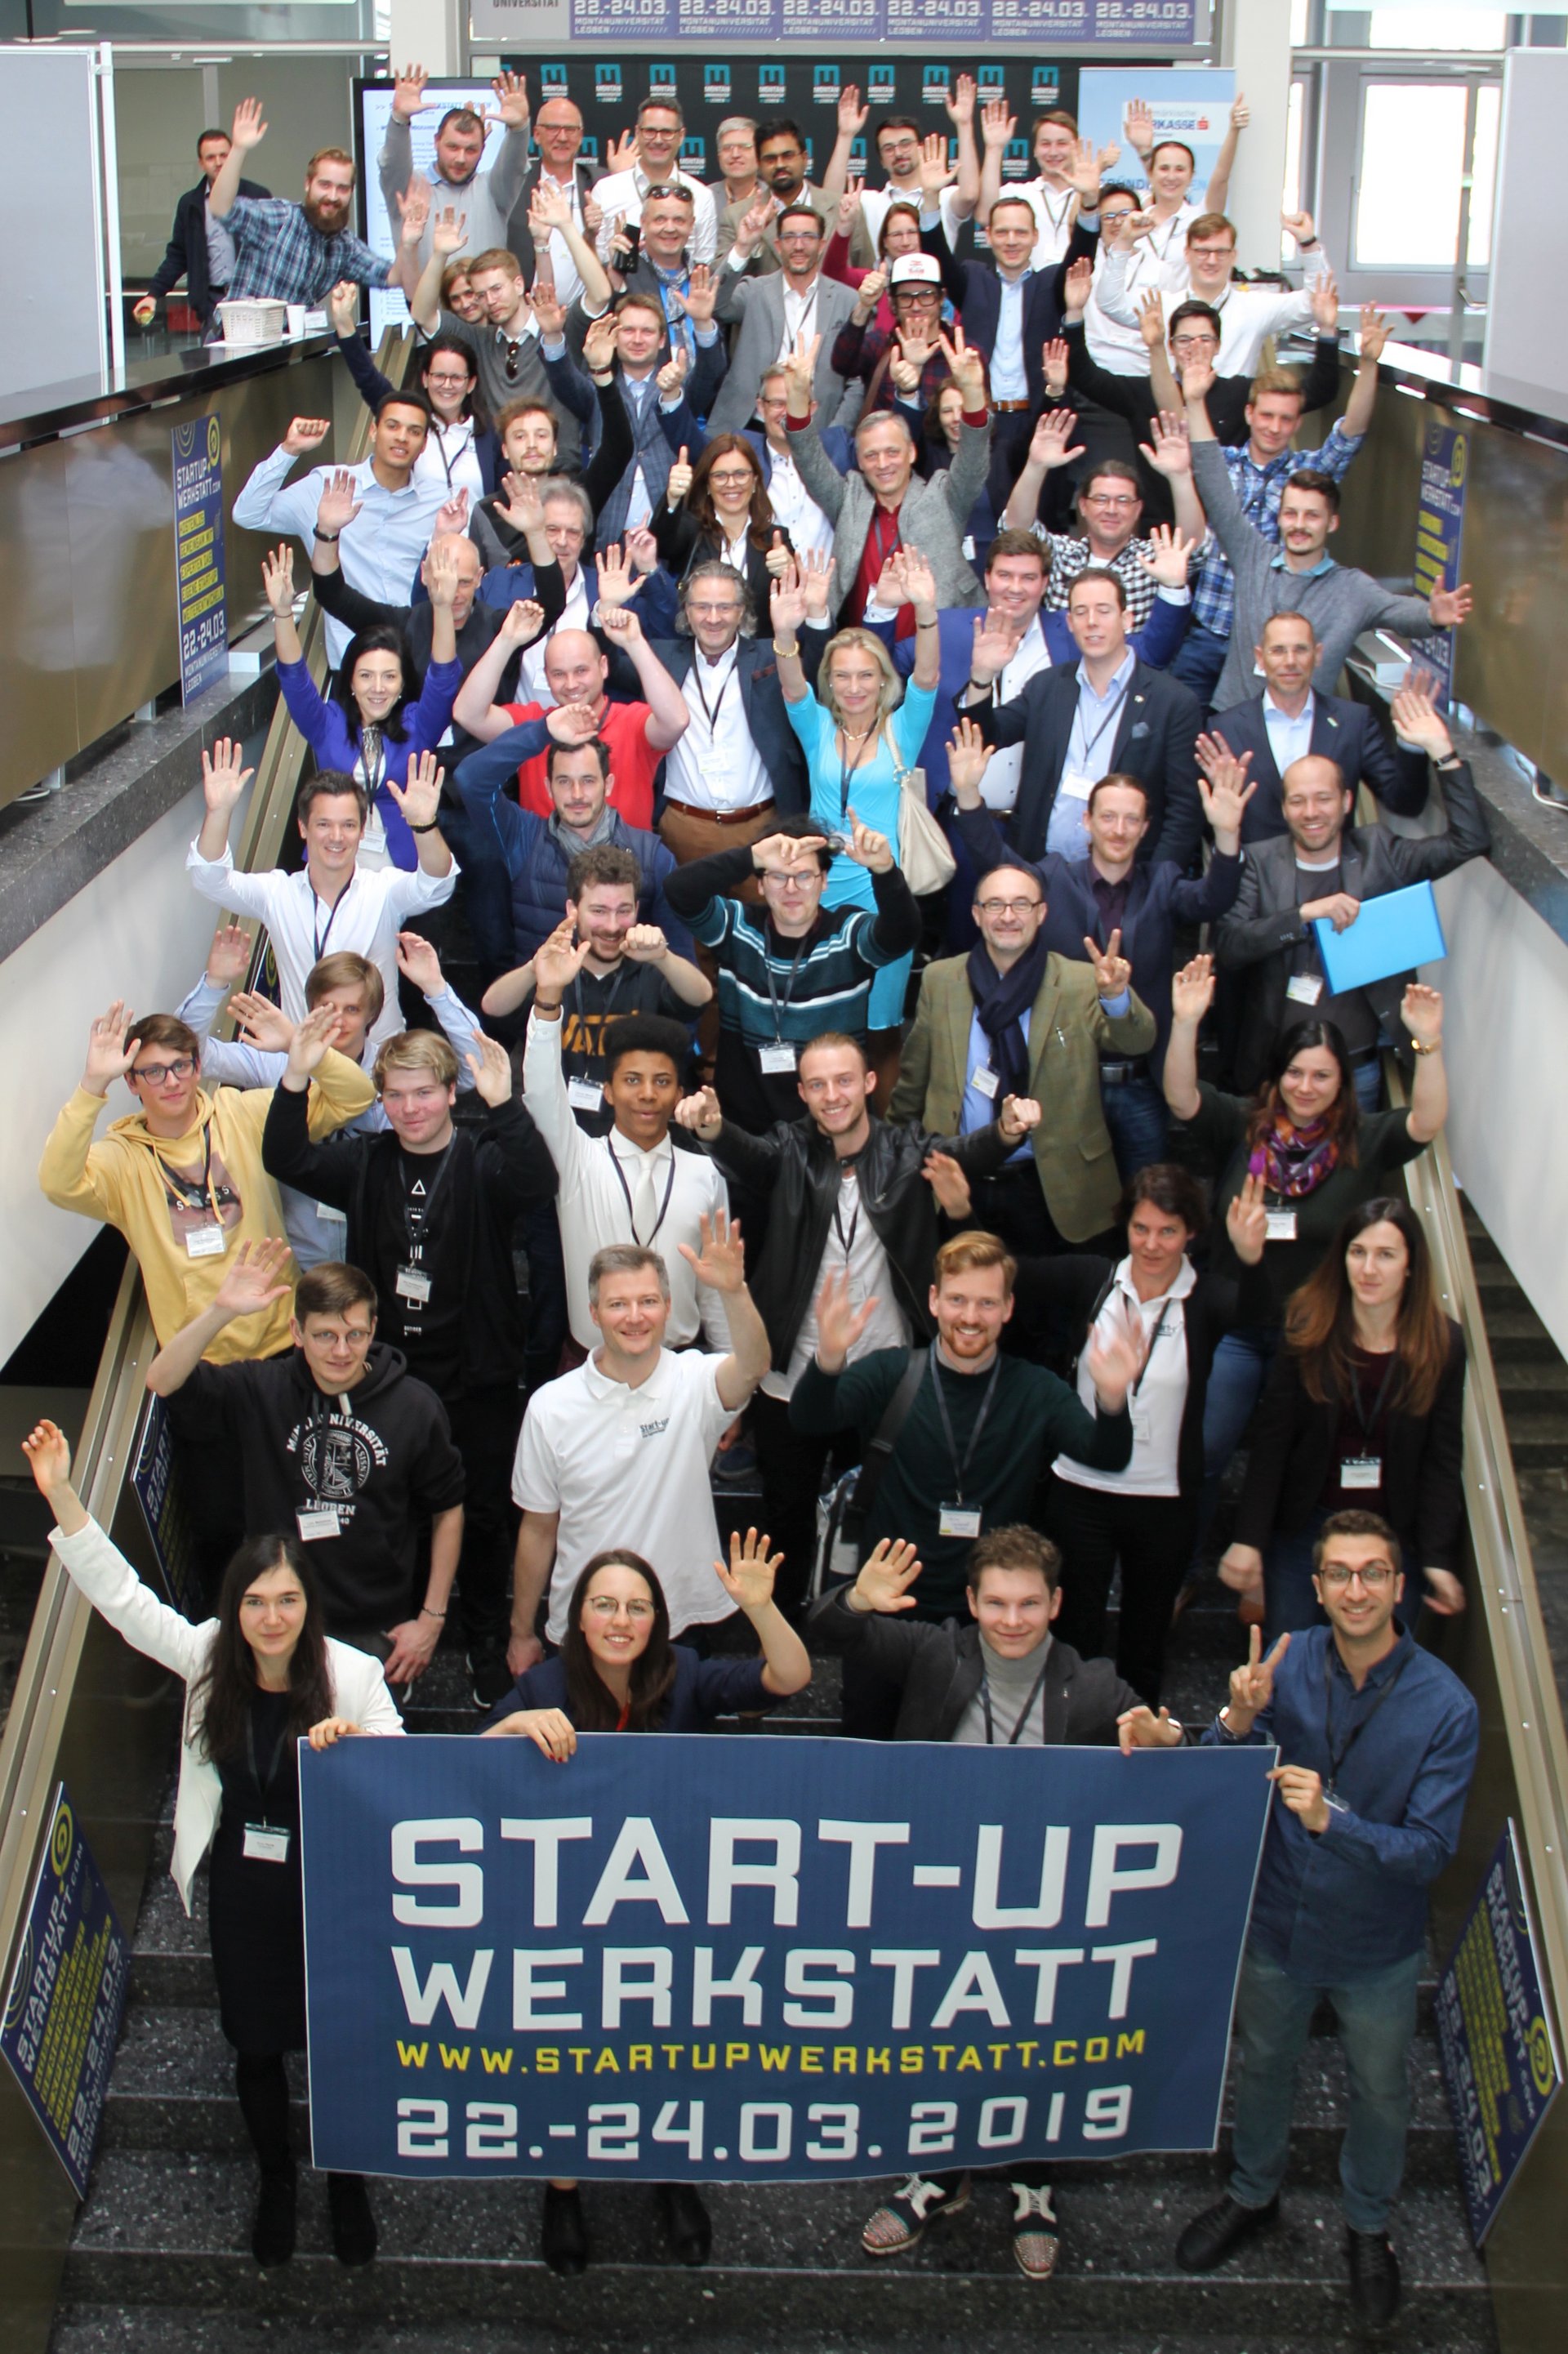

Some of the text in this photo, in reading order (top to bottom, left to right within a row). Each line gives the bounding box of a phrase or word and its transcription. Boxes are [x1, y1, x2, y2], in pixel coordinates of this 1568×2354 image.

[574, 0, 670, 15] 22.-24.03.
[679, 0, 775, 16] 22.-24.03.
[782, 0, 880, 16] 22.-24.03.
[887, 2, 985, 16] 22.-24.03.
[991, 2, 1089, 17] 22.-24.03.
[1095, 2, 1194, 18] 22.-24.03.
[1152, 119, 1196, 130] RKASSE
[176, 457, 207, 490] STARTUP
[183, 609, 225, 662] 22.-24.03.
[391, 1817, 1183, 1930] START-UP
[17, 1894, 60, 2066] STARTUP
[391, 1939, 1156, 2030] WERKSTATT
[397, 2029, 1145, 2074] WWW.STARTUPWERKSTATT.COM
